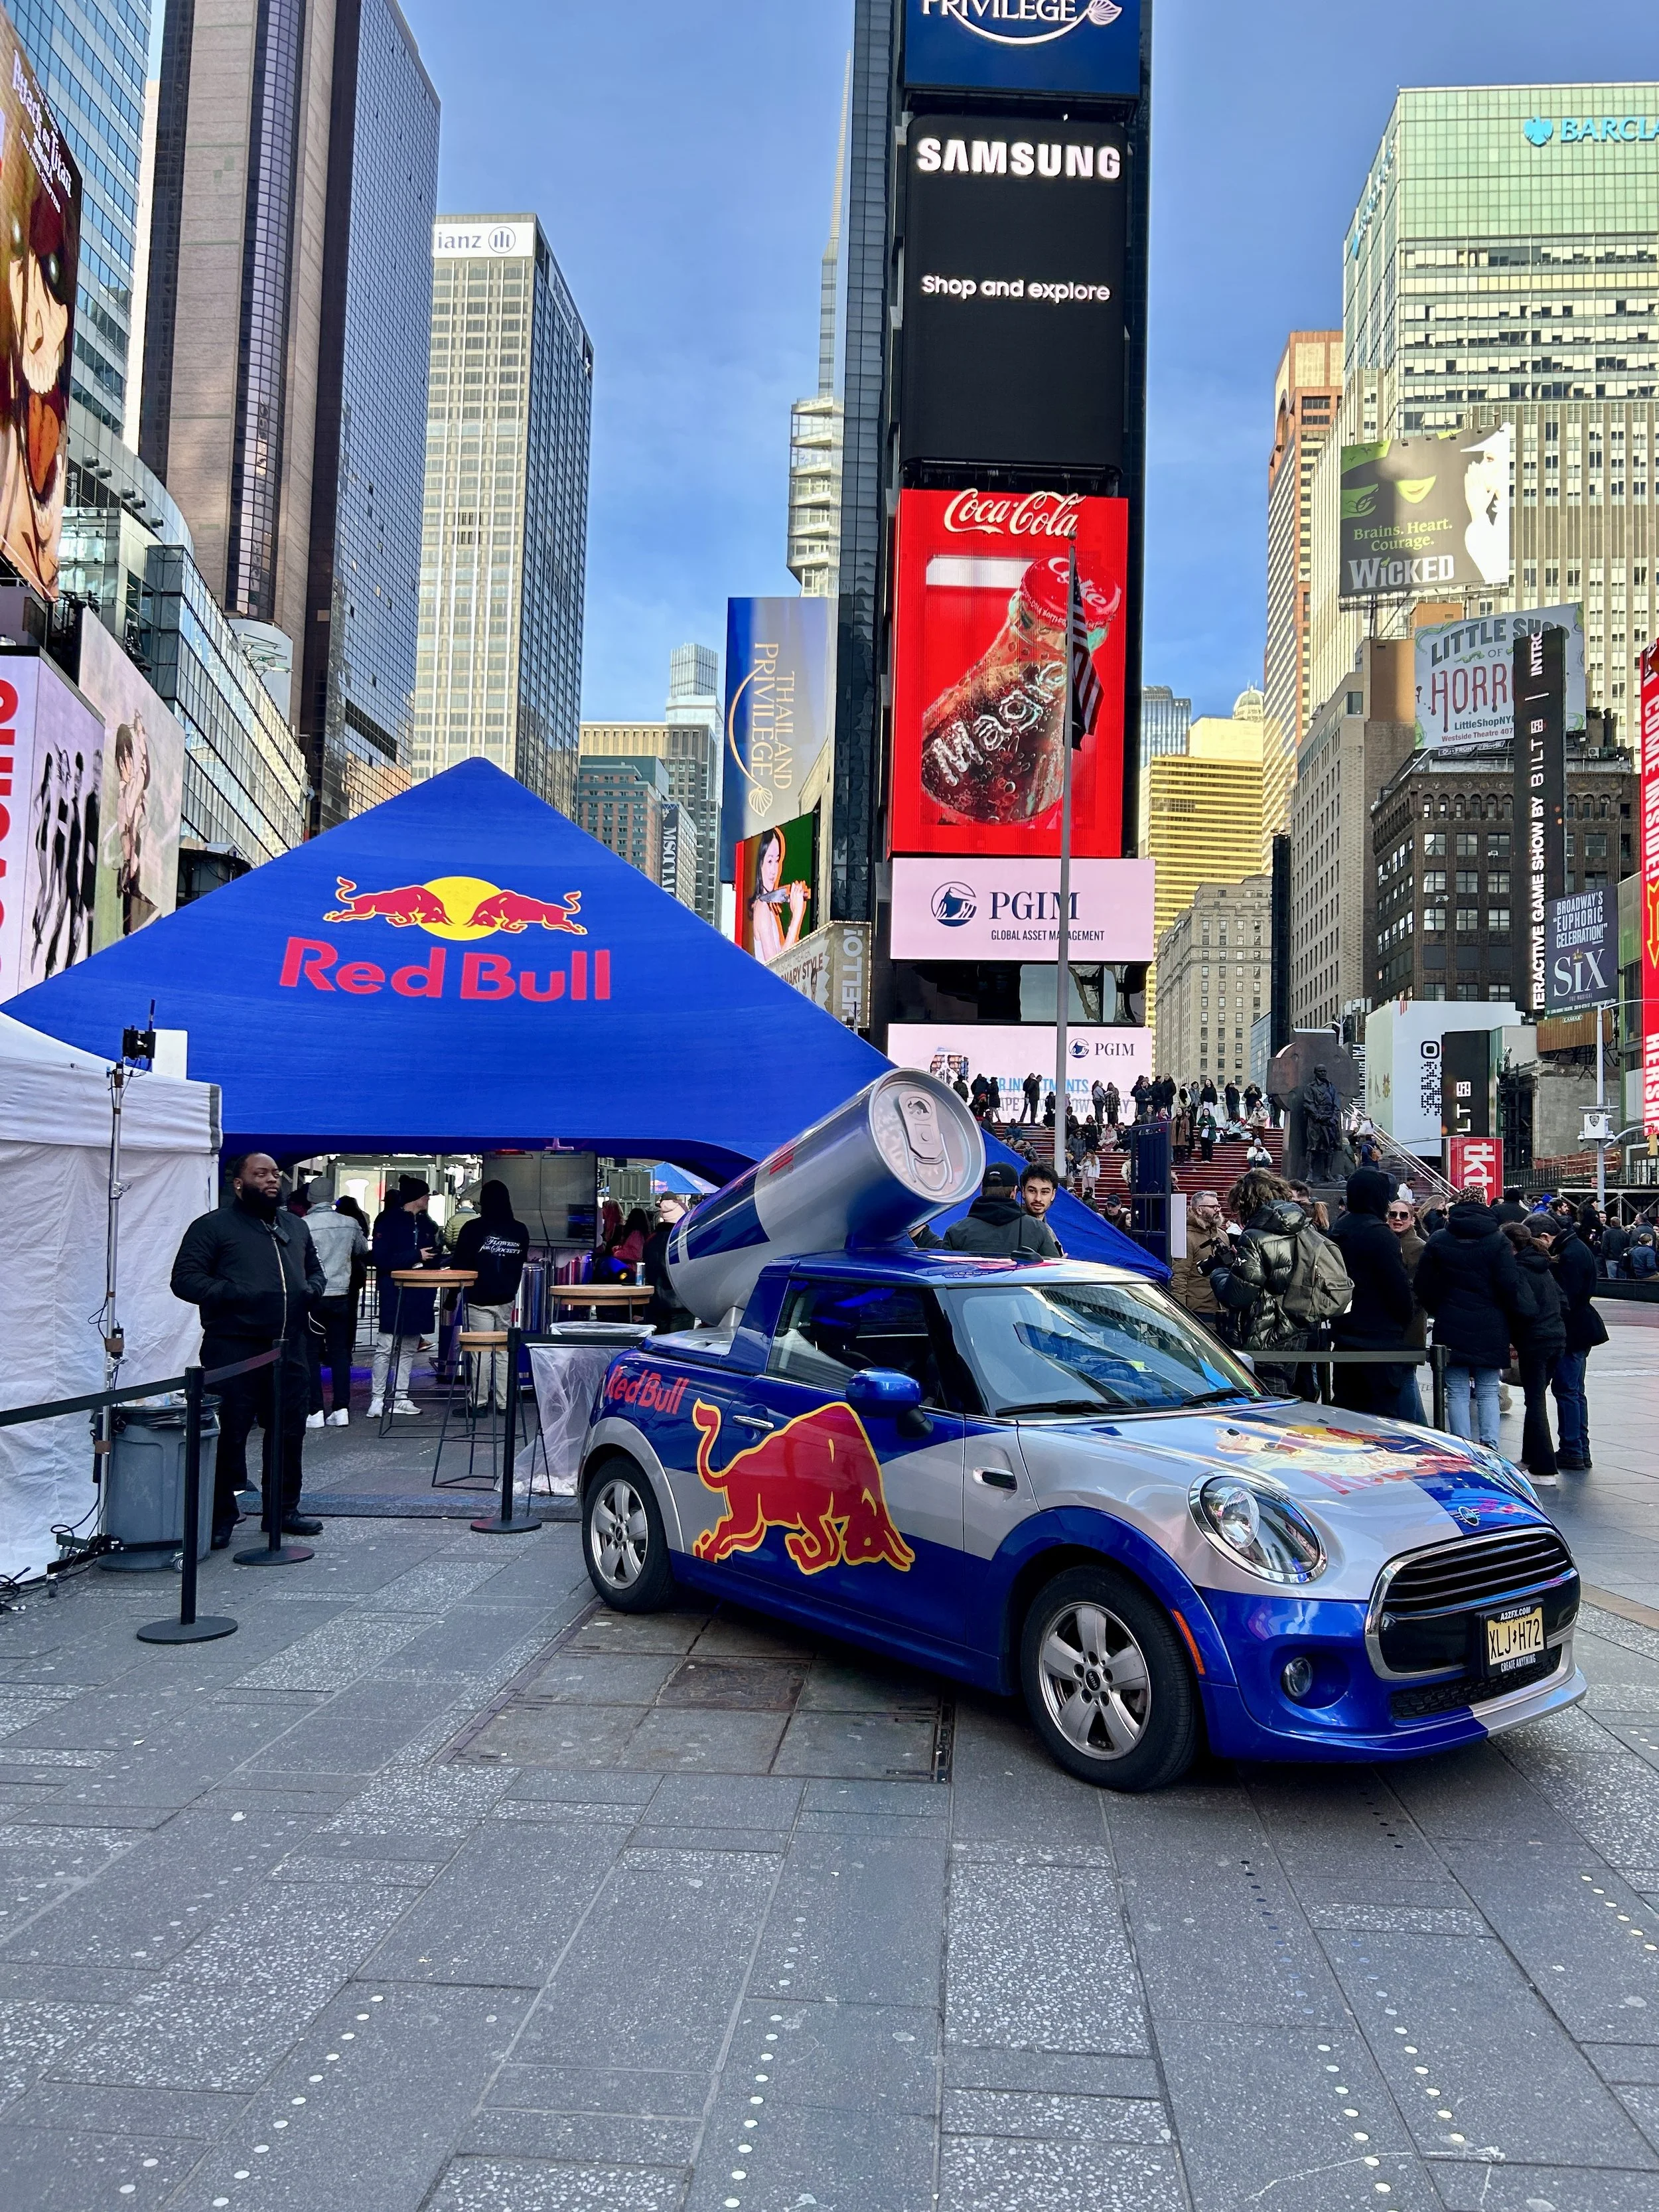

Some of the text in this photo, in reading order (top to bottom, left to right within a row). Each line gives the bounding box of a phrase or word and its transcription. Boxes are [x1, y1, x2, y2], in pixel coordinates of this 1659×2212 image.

[1561, 116, 1659, 143] BARCL
[916, 137, 1120, 179] SAMSUNG
[922, 275, 1110, 303] Shop and explore
[1354, 518, 1453, 540] Brains. Heart.
[1371, 536, 1435, 552] Courage.
[1431, 619, 1506, 668] LITTLE
[1488, 648, 1503, 658] OF
[751, 642, 779, 778] PRIVILEGE
[1431, 663, 1515, 733] HORR
[774, 670, 795, 790] THAILAND
[1441, 733, 1472, 742] Westside
[1473, 730, 1498, 741] Theatre
[1531, 739, 1544, 788] BILT
[1532, 796, 1544, 818] BY
[1532, 822, 1544, 871] SHOW
[989, 891, 1080, 920] PGIM
[1532, 874, 1545, 922] GAME
[1557, 891, 1603, 916] BROADWAY'S
[991, 930, 1105, 941] GLOBAL ASSET MAAGEMENT
[279, 936, 611, 1001] Red Bull
[1095, 1043, 1135, 1056] PGIM
[1464, 1143, 1494, 1200] tkt
[604, 1364, 690, 1415] Red Bull
[1500, 1606, 1531, 1621] A2ZFX.COM
[1489, 1618, 1541, 1659] XLJ H72
[1501, 1654, 1536, 1672] CREATE ANYTHING
